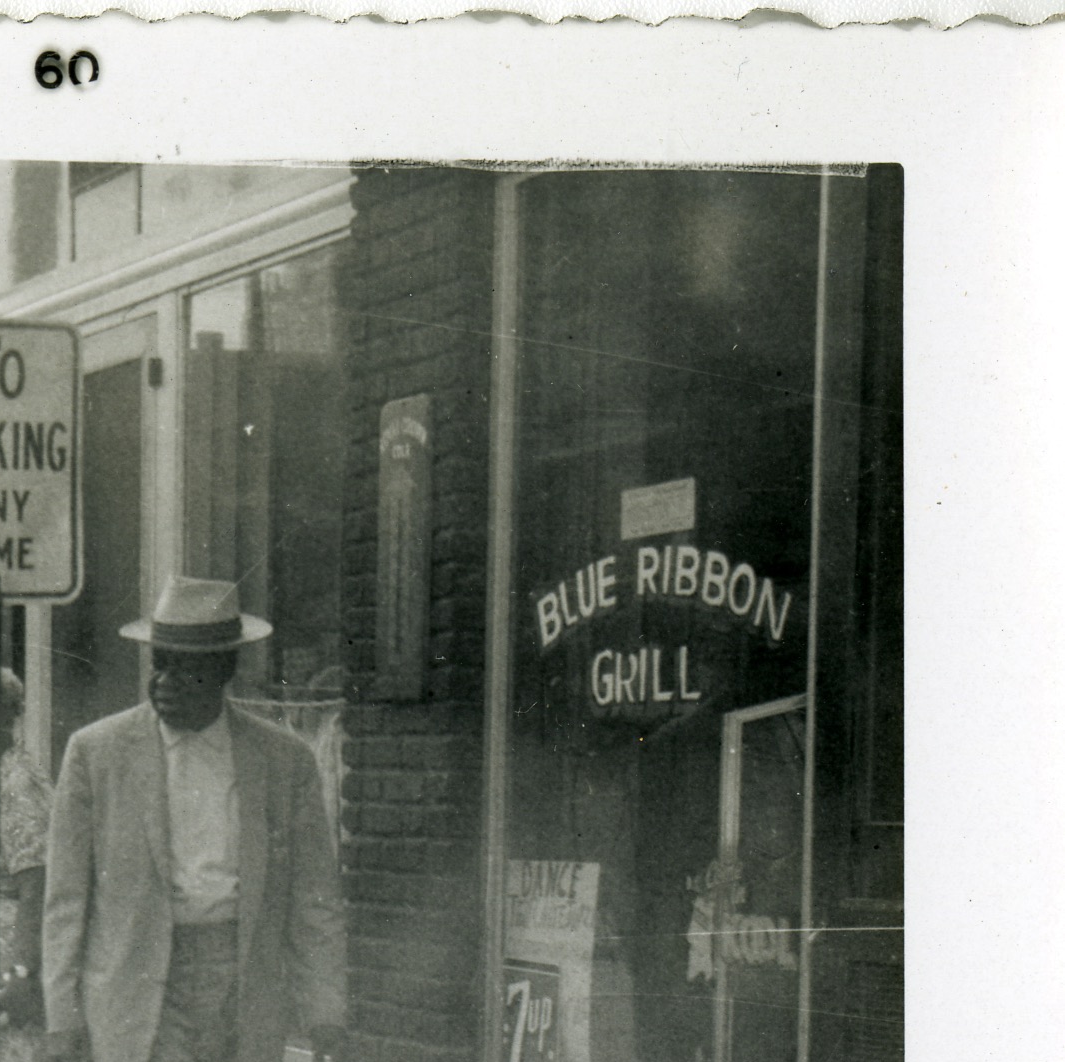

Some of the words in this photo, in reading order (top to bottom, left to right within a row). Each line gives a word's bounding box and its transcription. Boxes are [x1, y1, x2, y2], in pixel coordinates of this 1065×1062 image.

[537, 555, 617, 648] BLUE
[637, 545, 792, 643] RIBBON
[591, 646, 702, 706] GRILL
